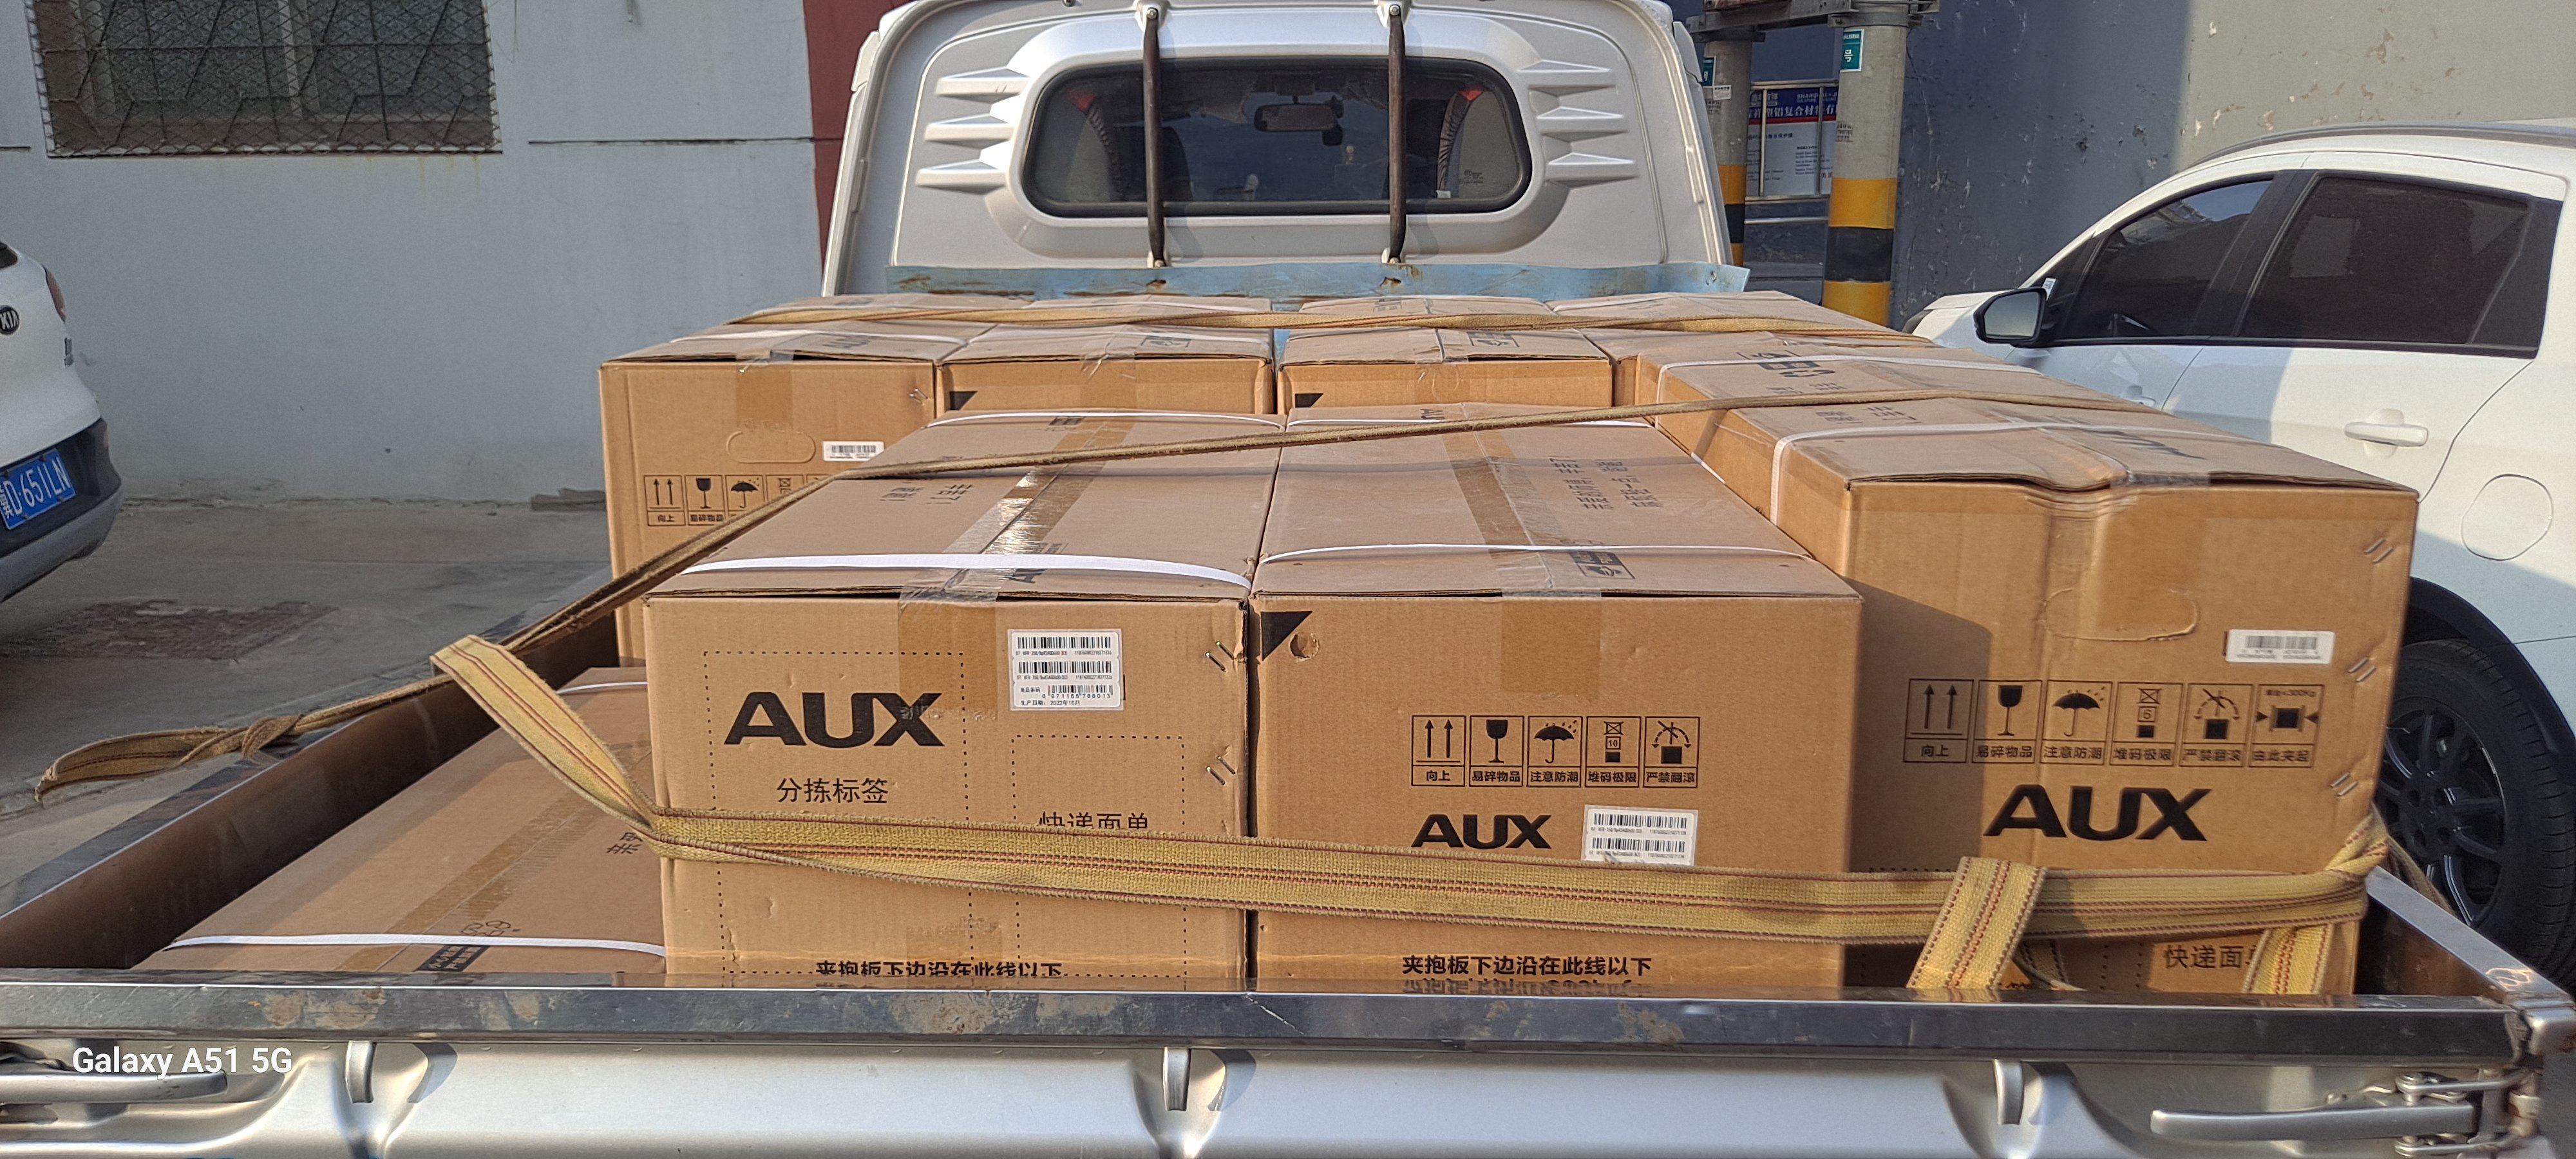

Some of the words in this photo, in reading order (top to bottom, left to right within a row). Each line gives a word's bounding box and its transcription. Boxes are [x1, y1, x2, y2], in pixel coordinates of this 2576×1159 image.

[0, 310, 19, 330] KIA
[658, 514, 676, 523] 向上
[723, 692, 945, 749] AUX
[2142, 709, 2152, 720] 6
[1608, 739, 1618, 748] 10
[1921, 745, 1949, 758] 向上
[1976, 745, 2032, 759] 易碎物品
[2043, 746, 2103, 760] 注意防潮
[2113, 748, 2172, 761] 堆码极限
[2183, 749, 2242, 762] 严禁翻滚
[2251, 750, 2309, 763] 由此夹起
[1426, 770, 1450, 782] 向上
[1472, 771, 1520, 782] 易碎物品
[1530, 771, 1578, 782] 注意防潮
[1587, 771, 1636, 783] 堆码极限
[1646, 771, 1696, 784] 严禁翻滚
[777, 777, 889, 804] 分拣标签
[1982, 784, 2213, 842] AUX
[1411, 813, 1552, 850] AUX
[1401, 955, 1653, 976] 夹抱板下边沿在此线以下
